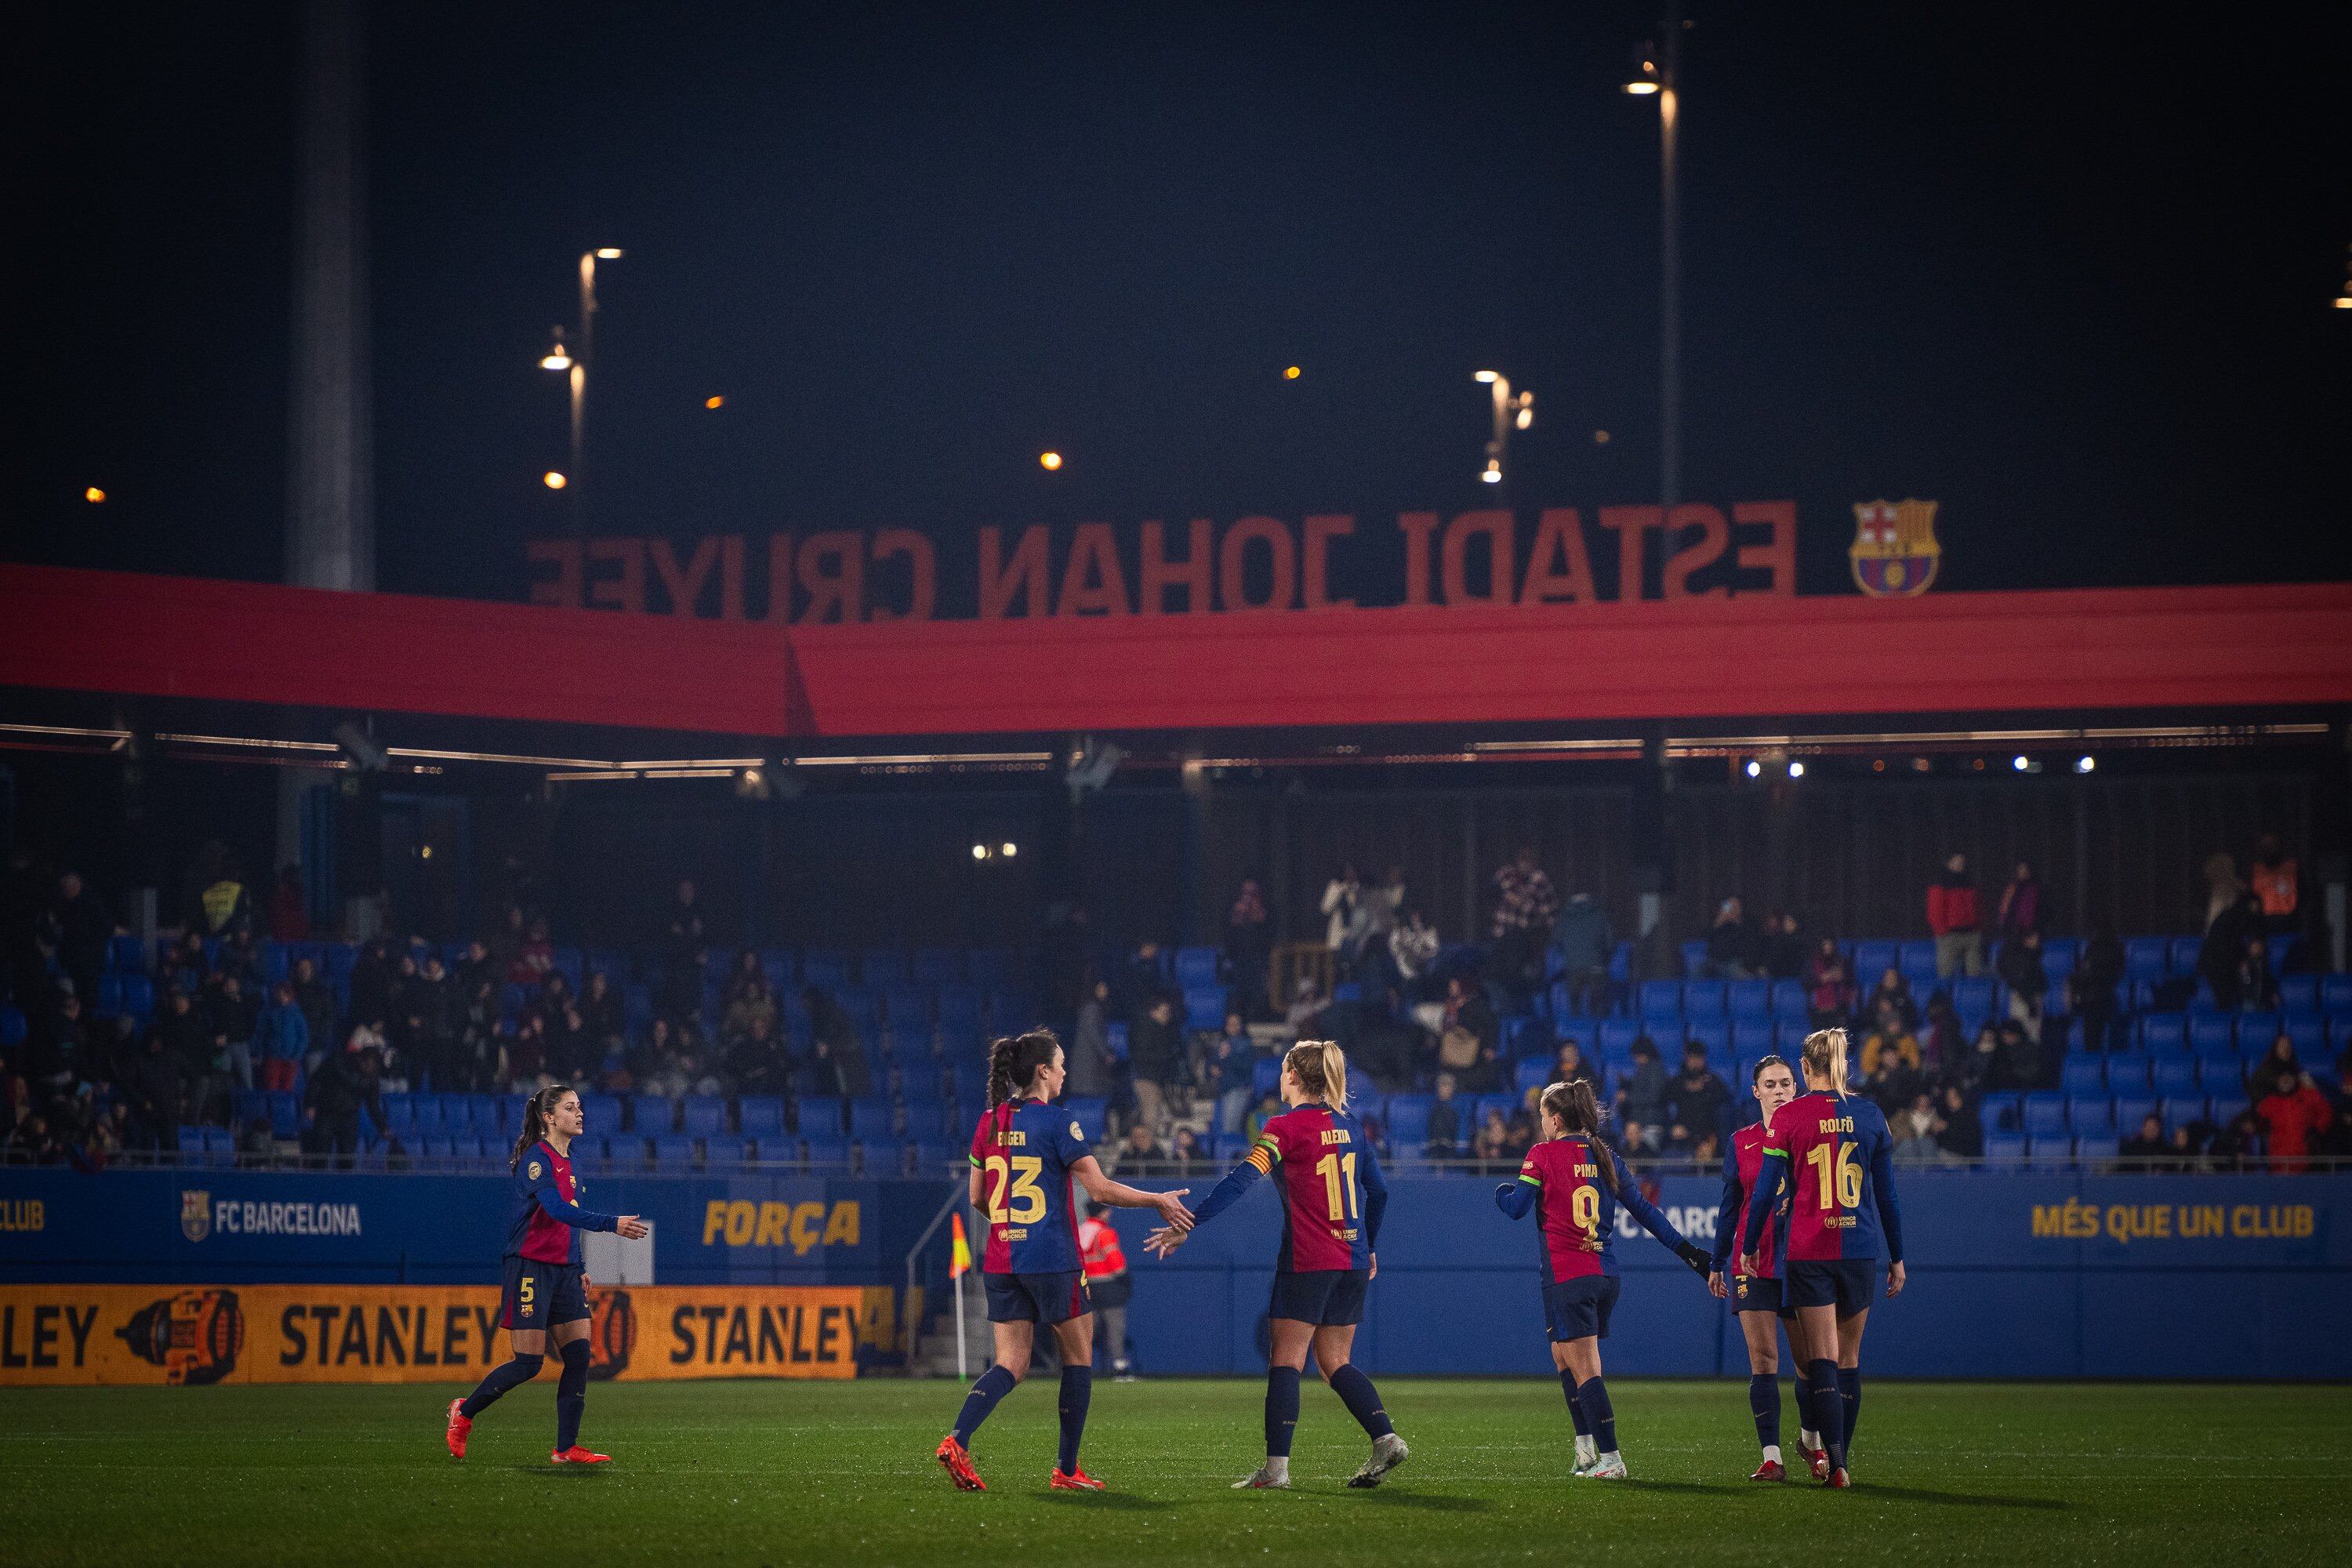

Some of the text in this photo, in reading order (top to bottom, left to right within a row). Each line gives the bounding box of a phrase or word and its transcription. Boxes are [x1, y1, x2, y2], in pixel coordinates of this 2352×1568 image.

[1321, 1129, 1352, 1145] ALEXIA
[1819, 1116, 1854, 1134] ROLFÖ
[985, 1155, 1047, 1224] 23
[1316, 1152, 1359, 1221] 11
[1573, 1163, 1599, 1178] PINA
[1806, 1142, 1864, 1210] 16
[216, 1200, 361, 1236] FC BARCELONA
[702, 1200, 861, 1256] FORÇA
[1572, 1185, 1600, 1242] 9
[2032, 1196, 2314, 1244] MÉS QUE UN CLUB
[521, 1277, 534, 1302] 5
[2, 1305, 99, 1367] LEY
[280, 1305, 502, 1366] STANLEY
